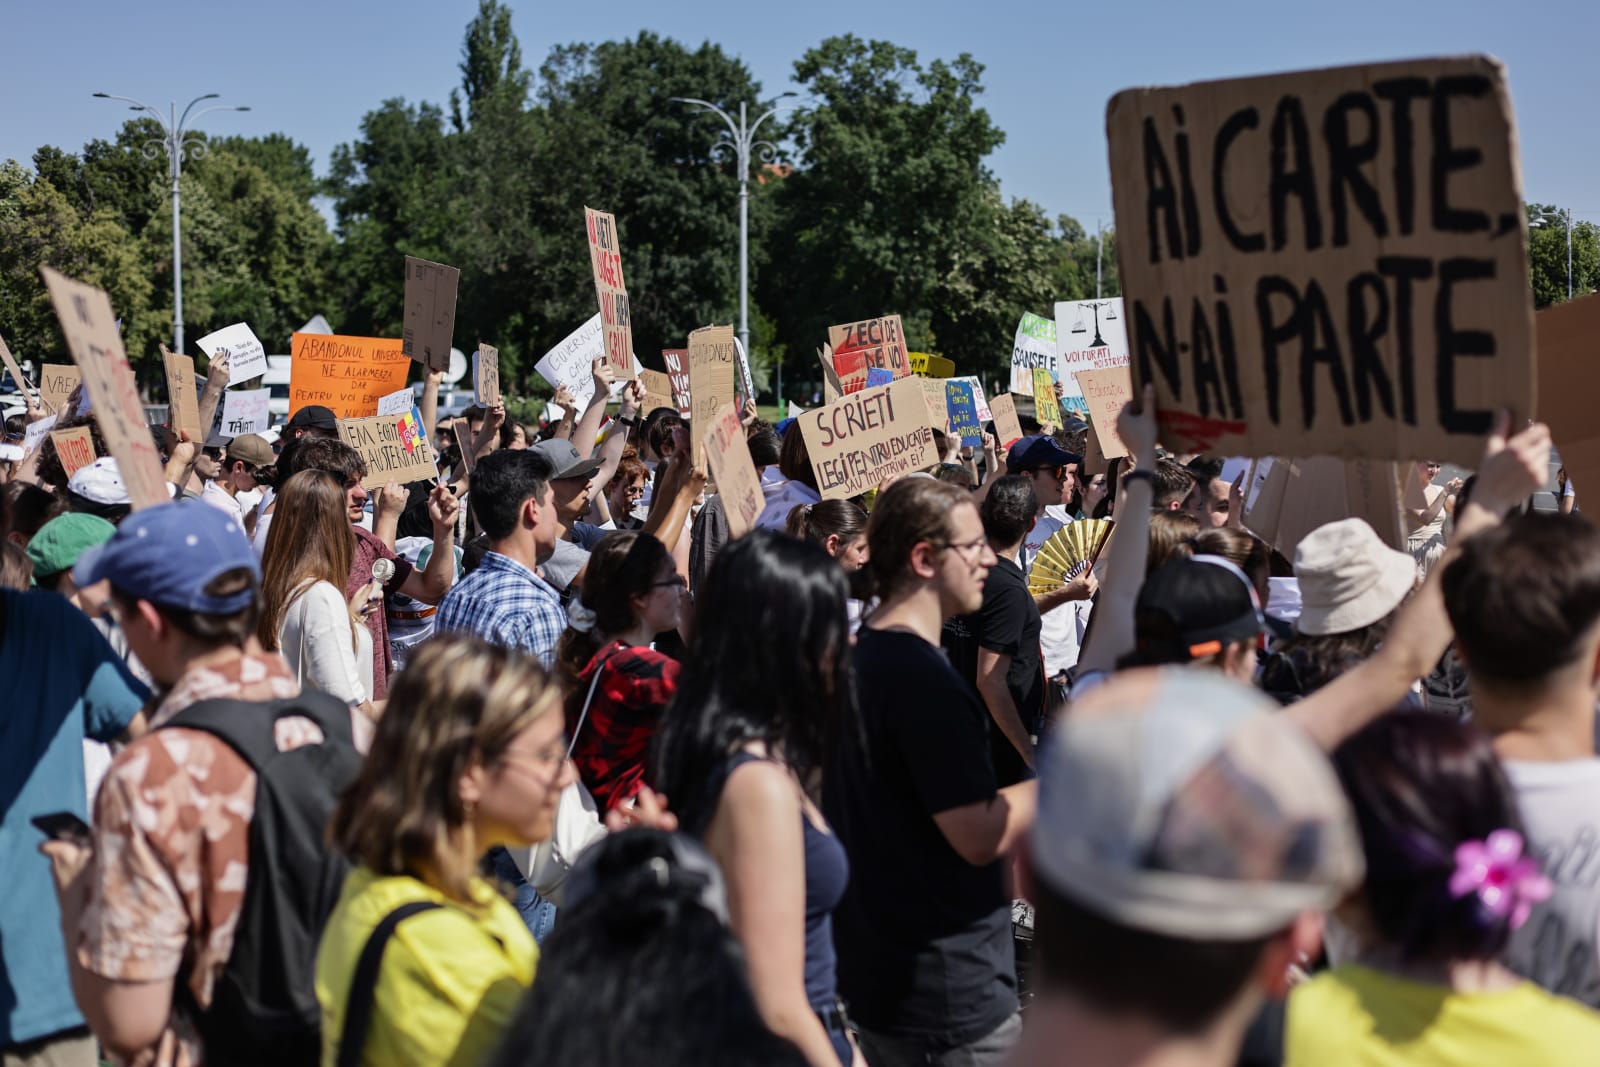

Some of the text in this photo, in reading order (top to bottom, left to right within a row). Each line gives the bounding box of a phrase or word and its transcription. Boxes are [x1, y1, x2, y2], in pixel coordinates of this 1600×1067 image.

[1212, 75, 1519, 252] CARTE,
[300, 339, 364, 360] ABANDONUL
[1257, 257, 1497, 434] PARTE
[322, 364, 337, 377] NE
[666, 353, 682, 373] NU
[296, 389, 333, 401] PENTRU
[352, 381, 367, 389] DAR
